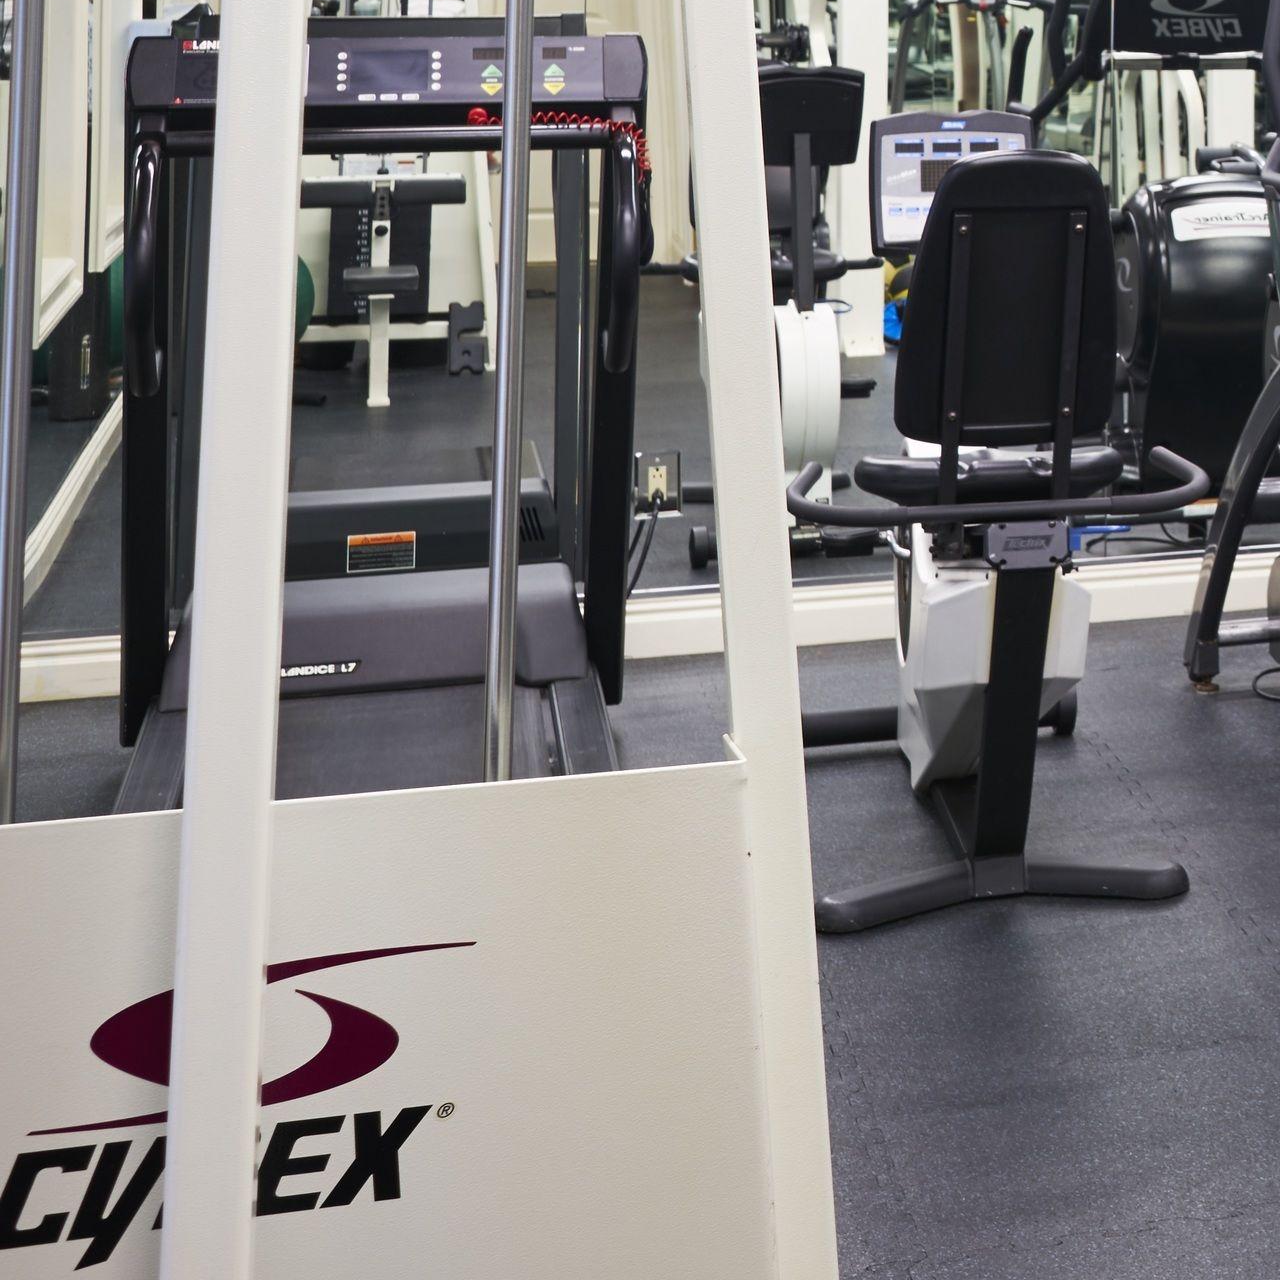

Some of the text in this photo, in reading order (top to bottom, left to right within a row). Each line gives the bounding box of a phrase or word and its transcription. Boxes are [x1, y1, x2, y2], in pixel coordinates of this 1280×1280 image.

[280, 662, 357, 678] LANDICE L7
[0, 1104, 433, 1271] CYEX
